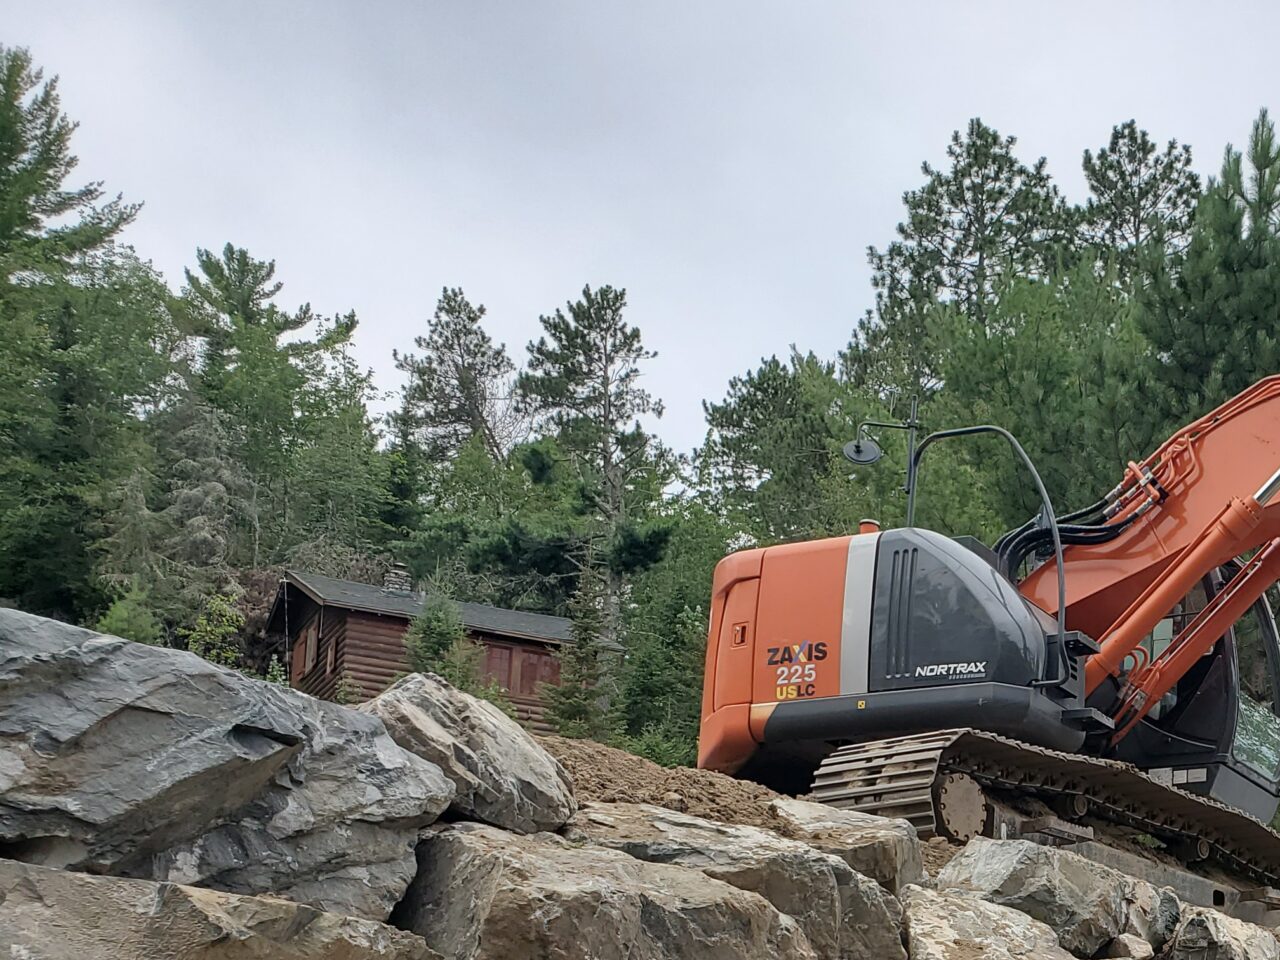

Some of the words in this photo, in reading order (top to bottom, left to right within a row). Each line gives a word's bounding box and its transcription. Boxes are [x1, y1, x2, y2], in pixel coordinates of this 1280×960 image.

[767, 640, 828, 665] ZAXIS
[776, 664, 816, 685] 225
[915, 661, 987, 677] NORTRAX
